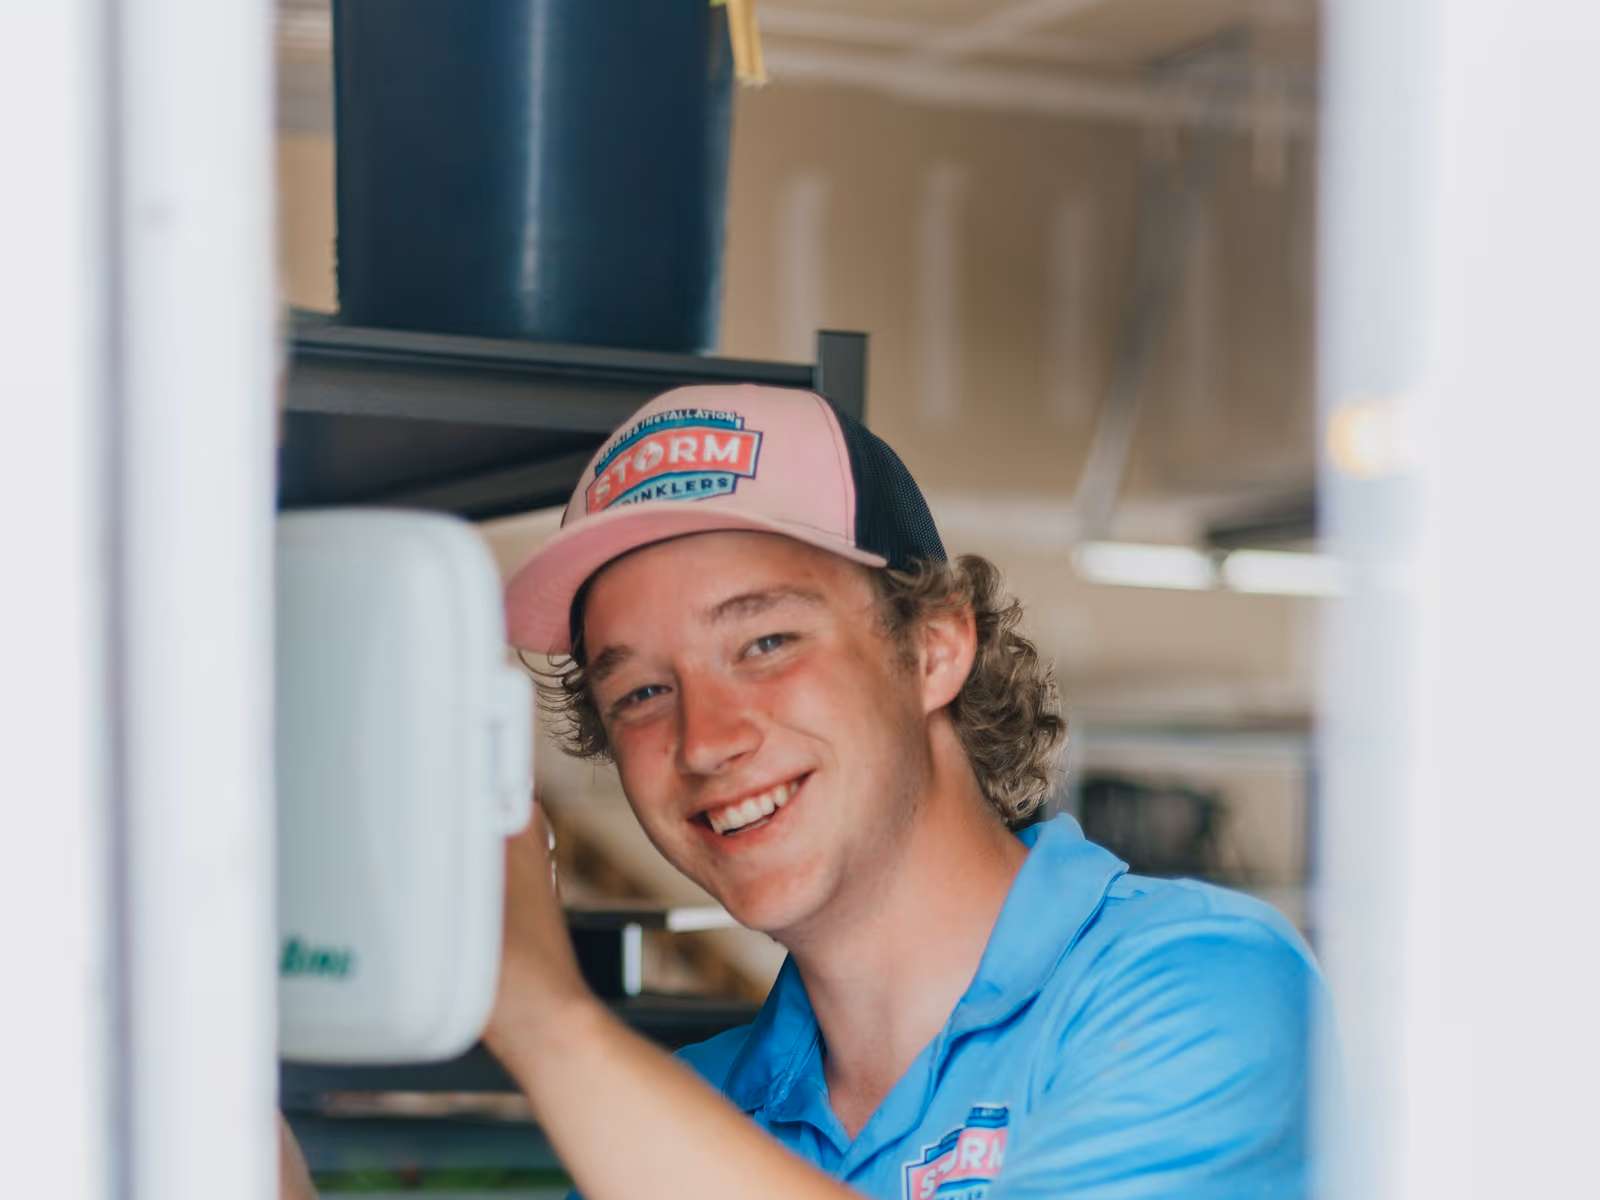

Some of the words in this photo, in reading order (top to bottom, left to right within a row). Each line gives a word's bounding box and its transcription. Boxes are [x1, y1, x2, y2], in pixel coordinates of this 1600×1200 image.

[641, 408, 736, 429] INSTALLATION
[594, 434, 741, 504] STORM
[617, 476, 730, 505] INKLERS
